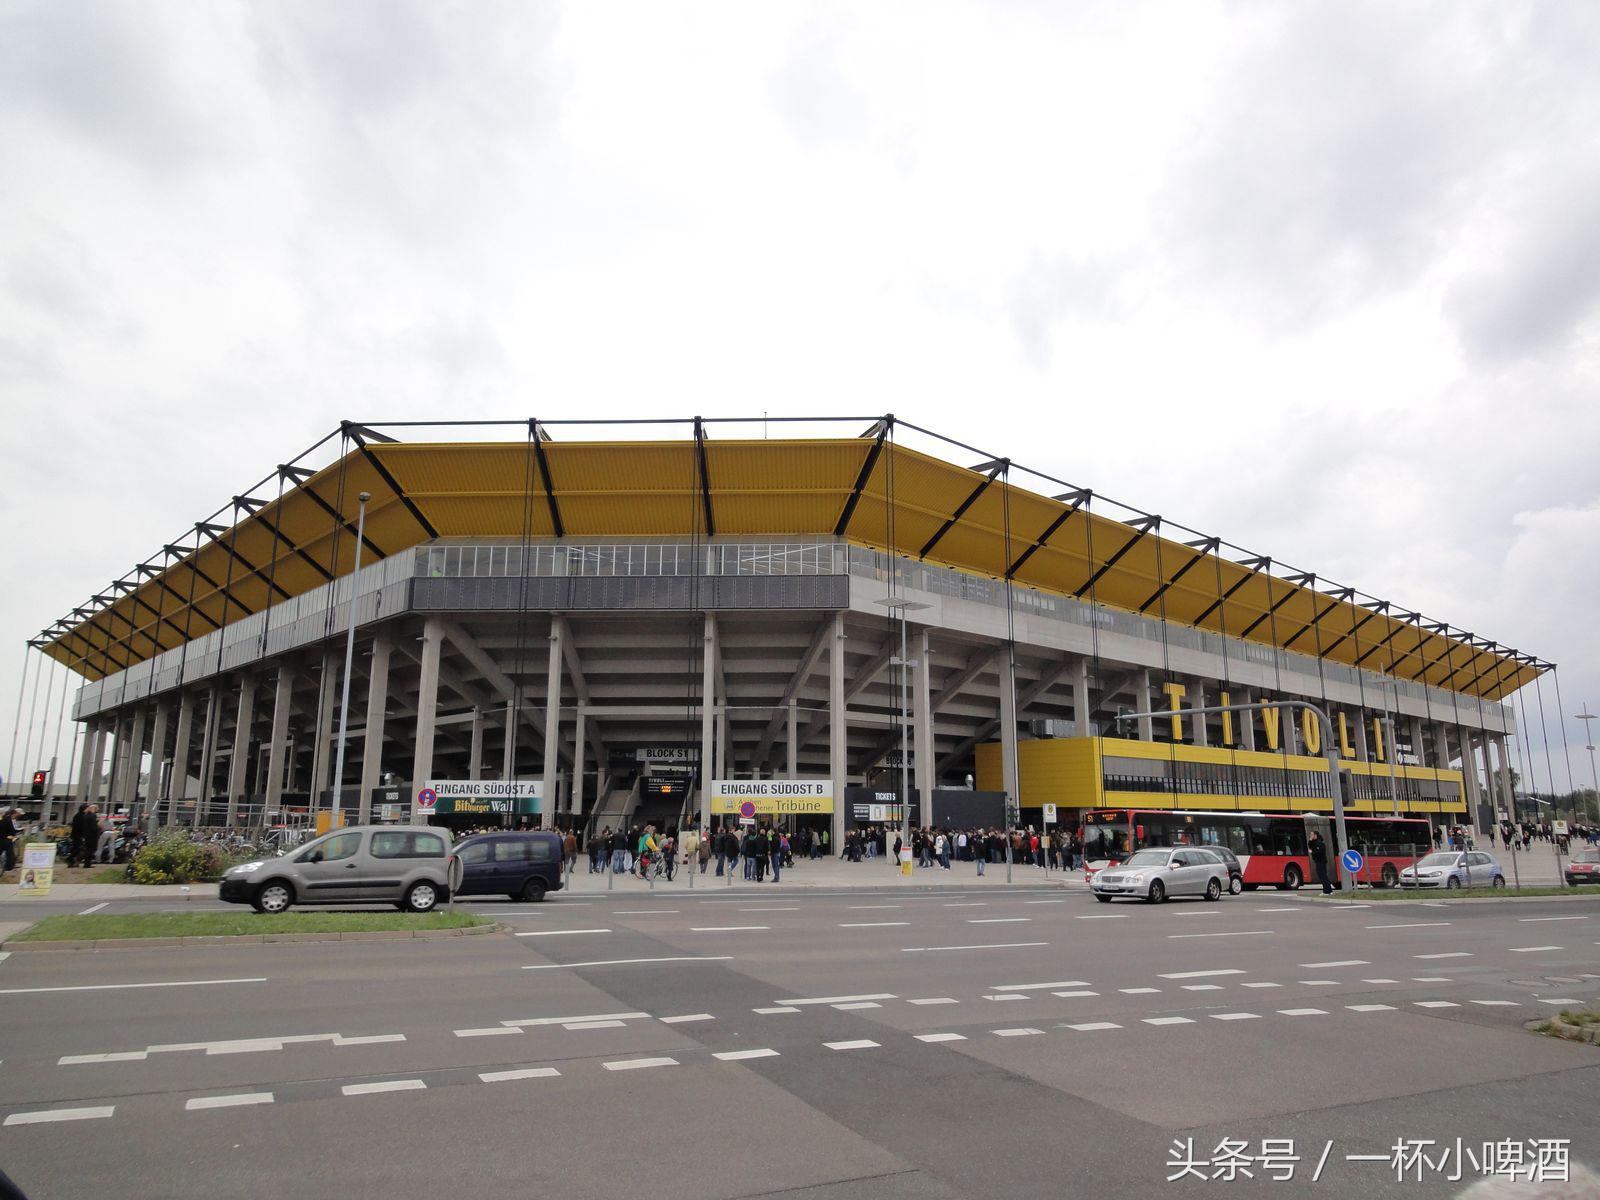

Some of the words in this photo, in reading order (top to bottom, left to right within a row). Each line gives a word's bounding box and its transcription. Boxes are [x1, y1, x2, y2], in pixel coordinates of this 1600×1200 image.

[1163, 682, 1388, 761] TIVOLI
[646, 749, 674, 758] BLOCK
[677, 749, 688, 758] S1
[435, 784, 480, 795] EINGANG
[484, 782, 525, 795] SÜDOST
[528, 785, 535, 795] A
[721, 784, 768, 795] EINGANG
[771, 782, 813, 795] SÜDOST
[816, 784, 823, 795] B
[875, 792, 896, 801] TICKETS
[455, 799, 490, 813] Bitburger
[491, 800, 513, 812] Wall
[775, 800, 821, 811] Tribüne
